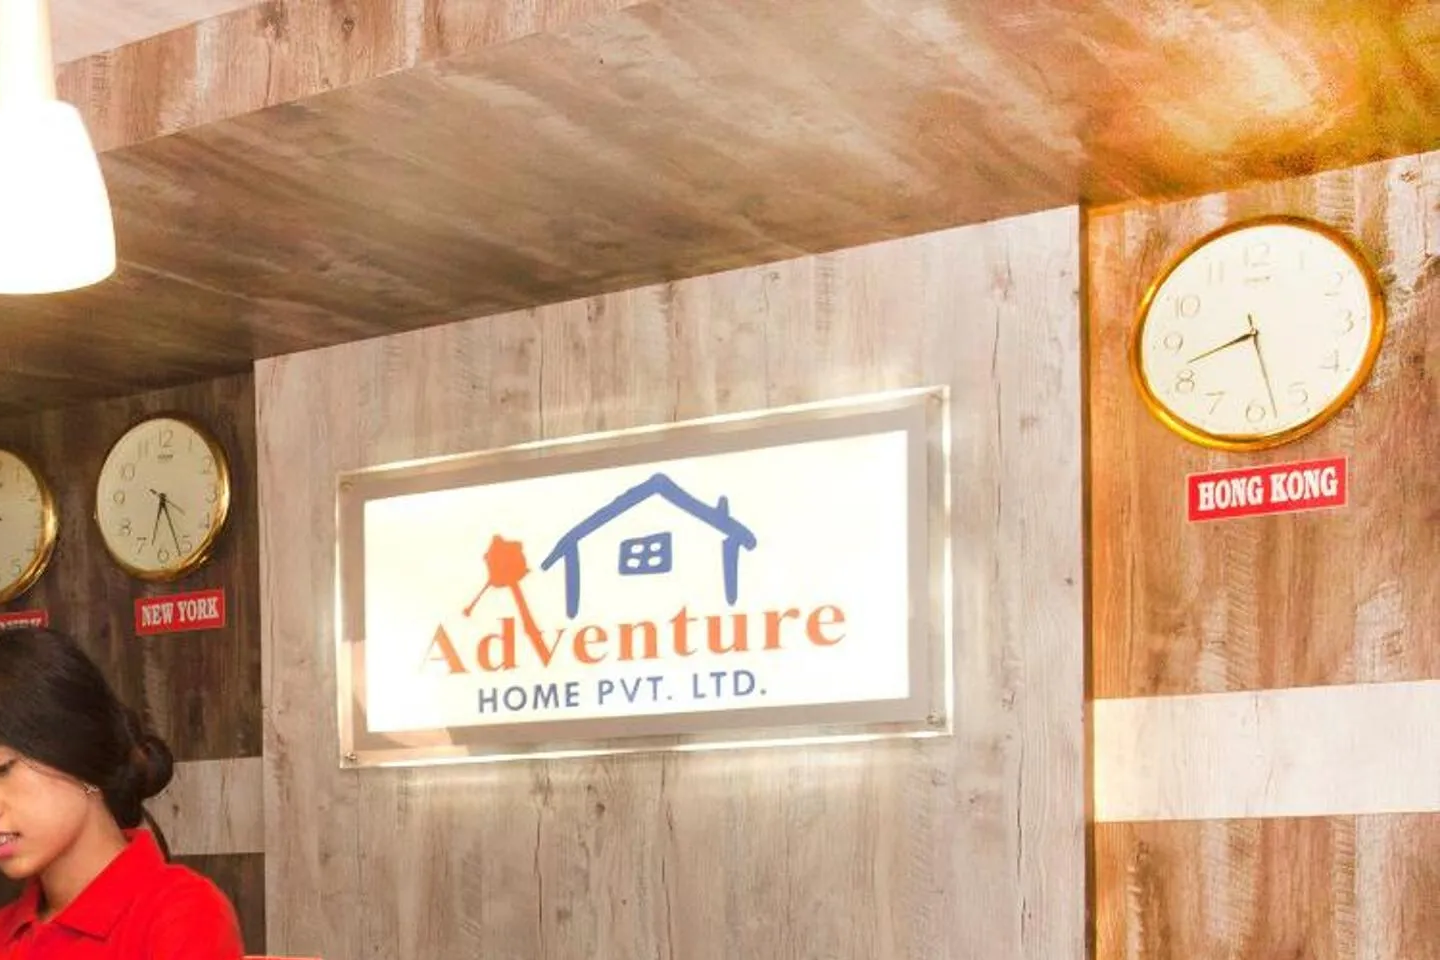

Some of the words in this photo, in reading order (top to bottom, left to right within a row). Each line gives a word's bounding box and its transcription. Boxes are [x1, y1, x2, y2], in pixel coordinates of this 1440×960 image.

[1245, 242, 1270, 267] 12
[1324, 272, 1343, 297] 2
[1175, 293, 1201, 319] 10
[1342, 309, 1354, 334] 3
[1318, 348, 1340, 373] 4
[1175, 369, 1196, 394] 8
[1287, 381, 1309, 405] 5
[1204, 390, 1226, 416] 7
[159, 429, 174, 448] 12
[1198, 477, 1264, 512] HONG
[1270, 467, 1339, 503] KONG
[141, 602, 173, 628] NEW
[176, 598, 220, 624] YORK
[477, 681, 581, 714] HOME
[597, 675, 672, 706] PVT.
[692, 669, 767, 700] LTD.
